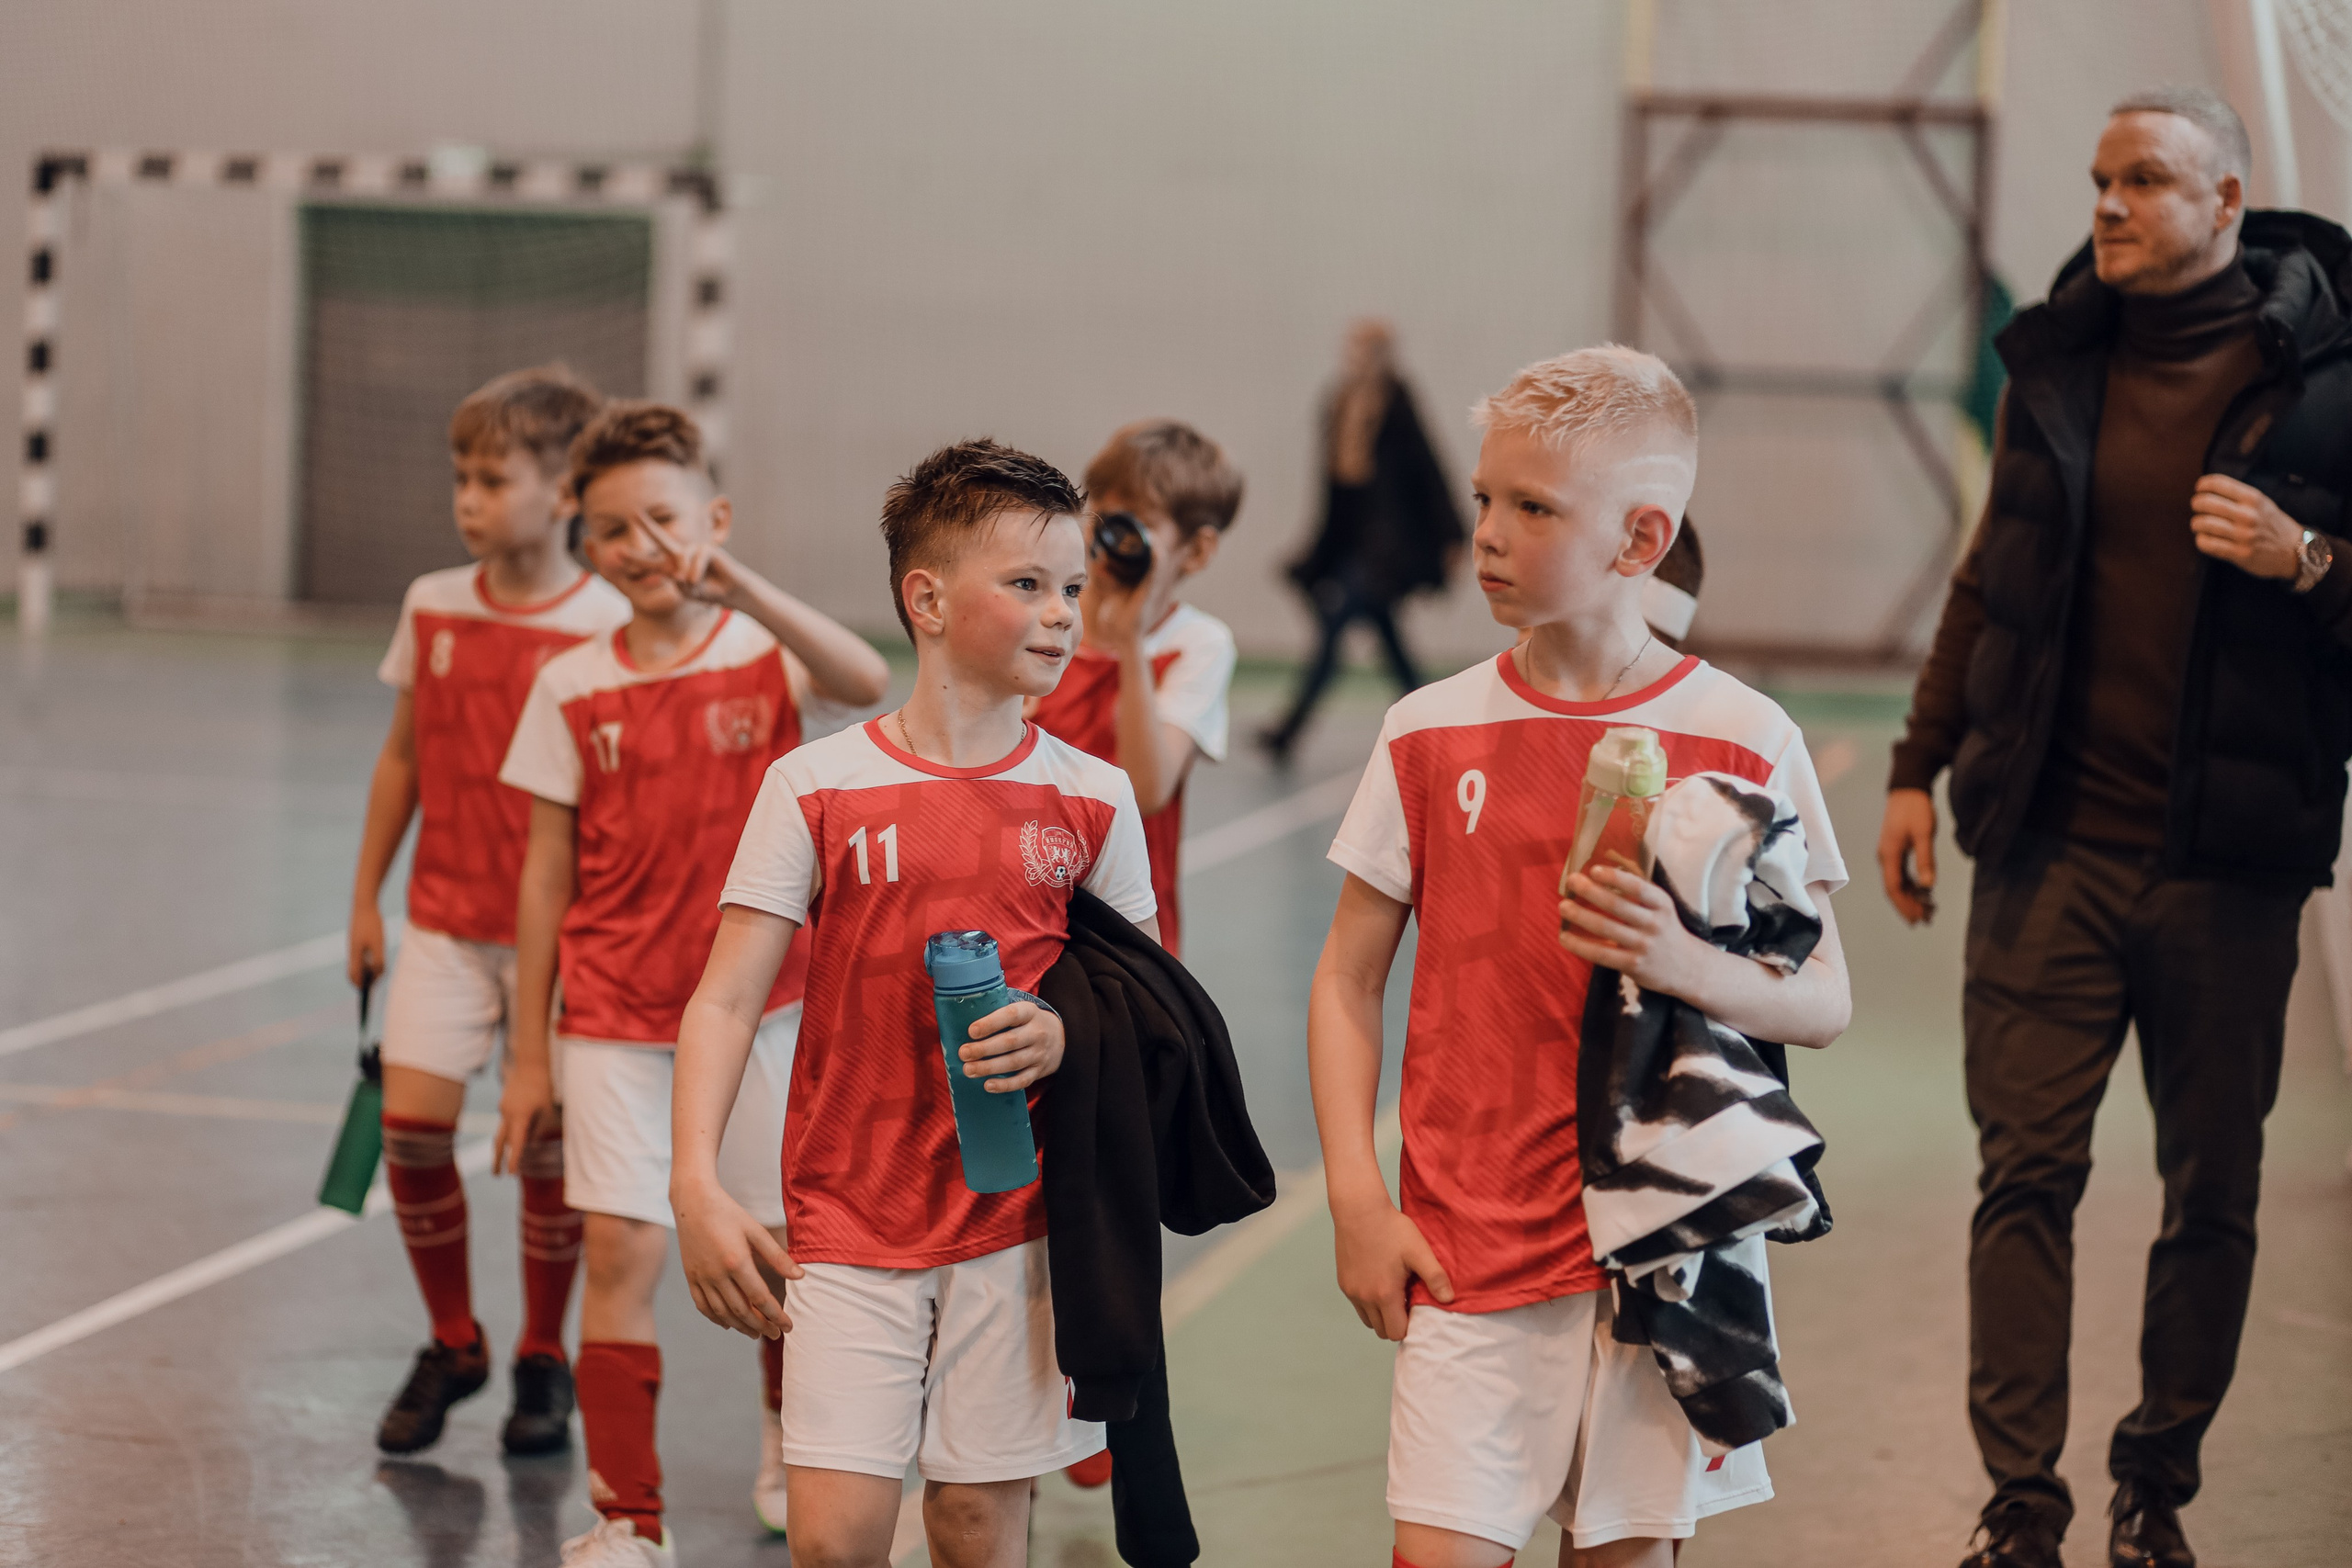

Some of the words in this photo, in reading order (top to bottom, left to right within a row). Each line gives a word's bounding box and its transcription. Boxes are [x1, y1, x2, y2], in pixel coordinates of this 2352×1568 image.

[591, 721, 622, 773] 17
[1456, 769, 1487, 835] 9
[848, 823, 899, 885] 11
